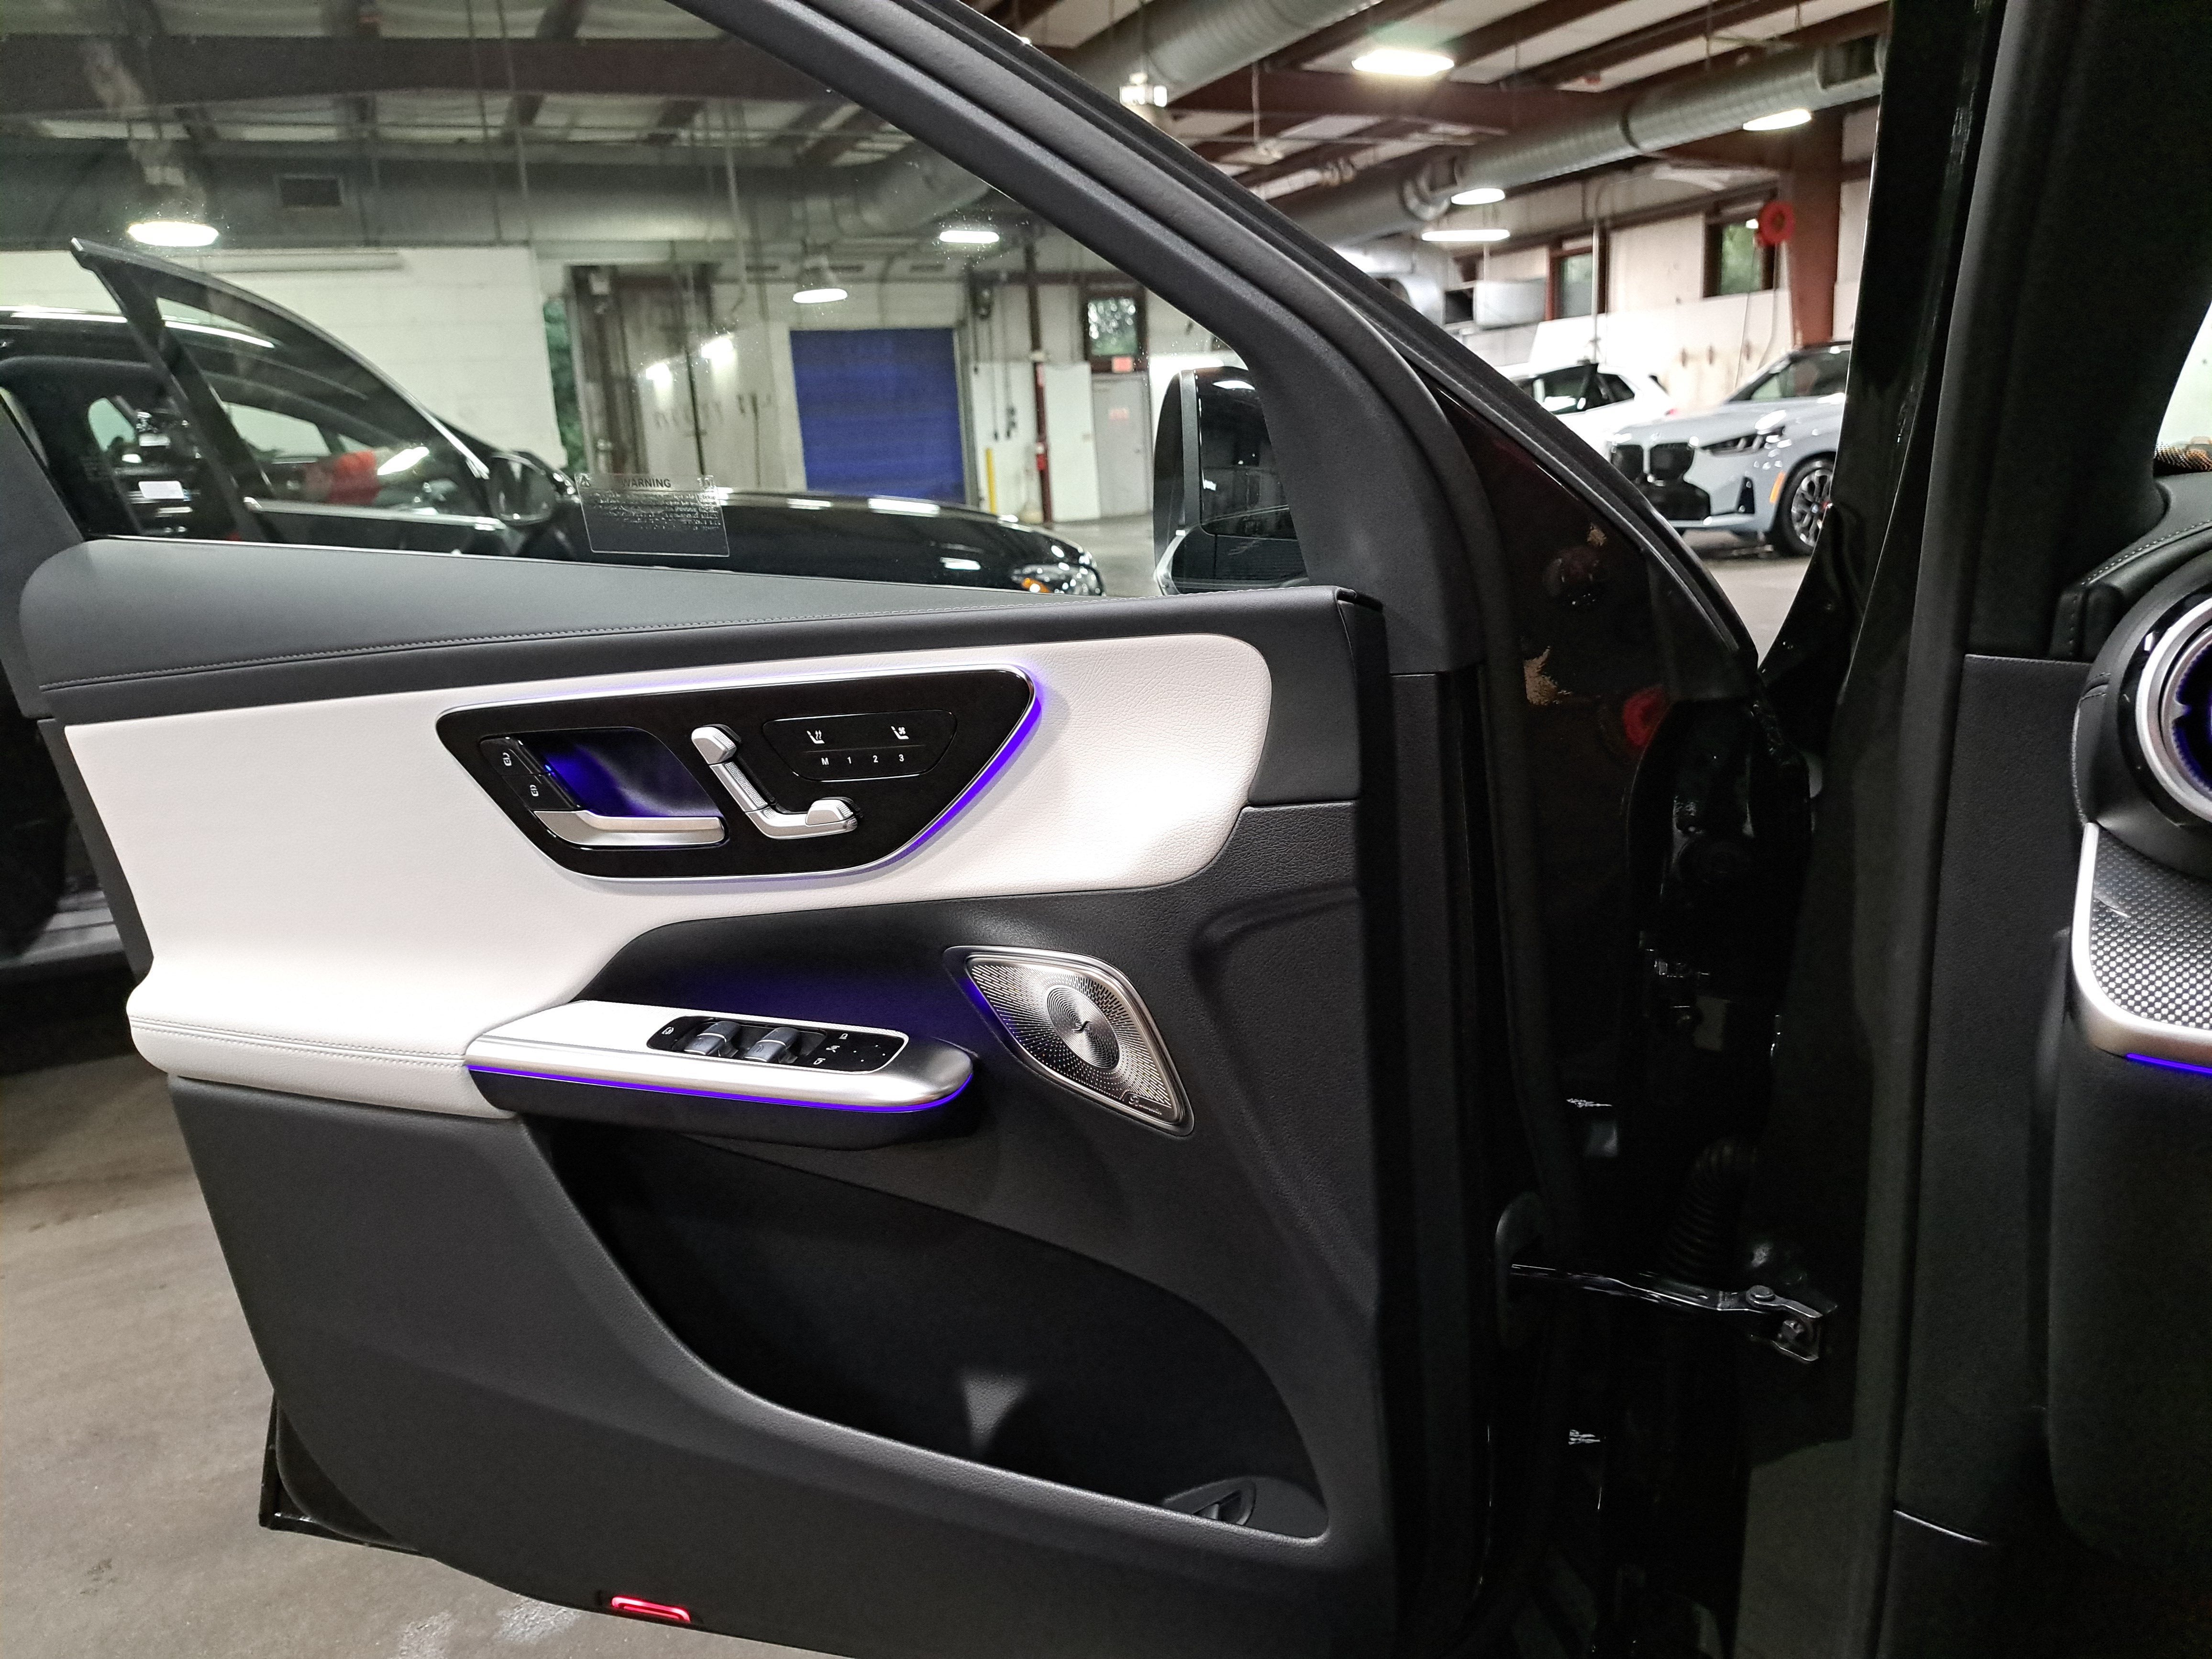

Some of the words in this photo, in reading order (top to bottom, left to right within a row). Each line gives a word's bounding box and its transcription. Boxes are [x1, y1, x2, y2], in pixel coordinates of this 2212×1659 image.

[622, 478, 671, 488] WARNING
[821, 757, 829, 765] M
[873, 755, 879, 763] 2
[898, 754, 904, 762] 3
